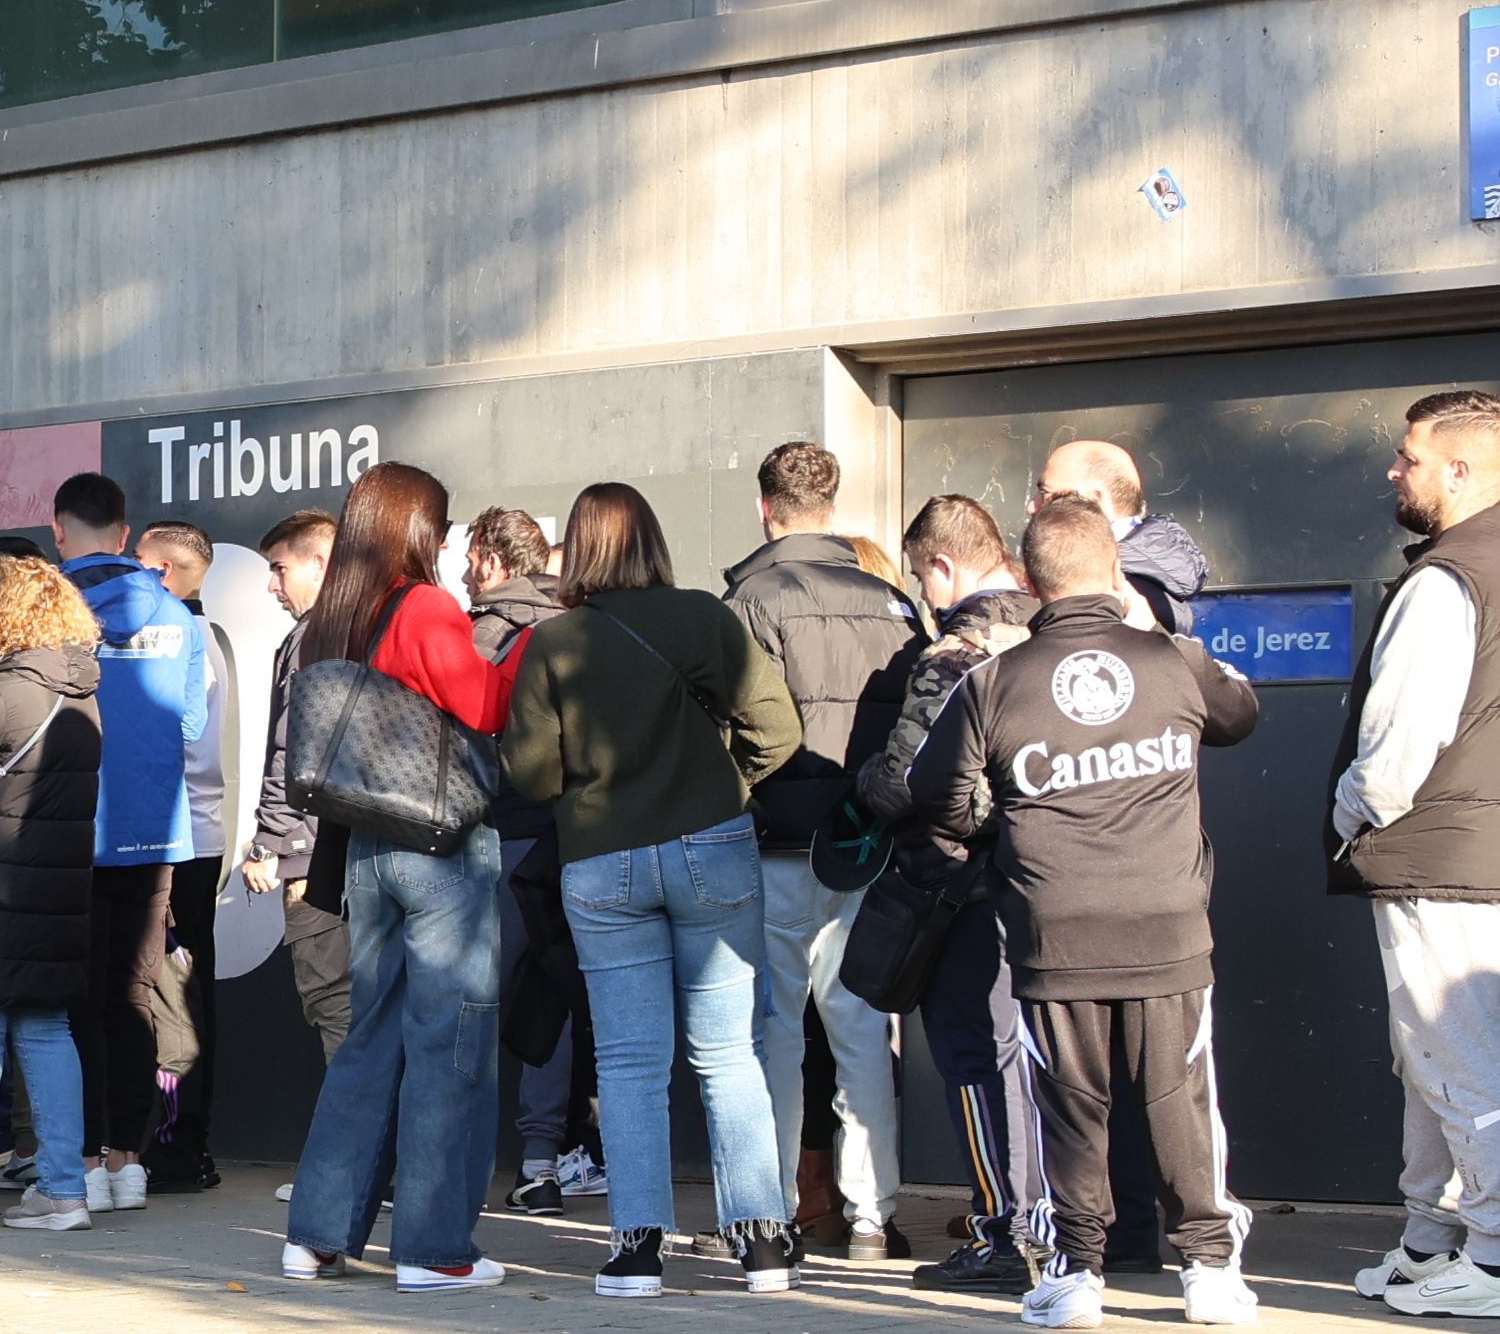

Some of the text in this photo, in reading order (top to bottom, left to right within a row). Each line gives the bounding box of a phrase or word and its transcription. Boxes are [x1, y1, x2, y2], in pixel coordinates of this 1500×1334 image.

[148, 419, 380, 504] Tribuna
[1211, 626, 1332, 659] de Jerez
[1012, 725, 1193, 797] Canasta
